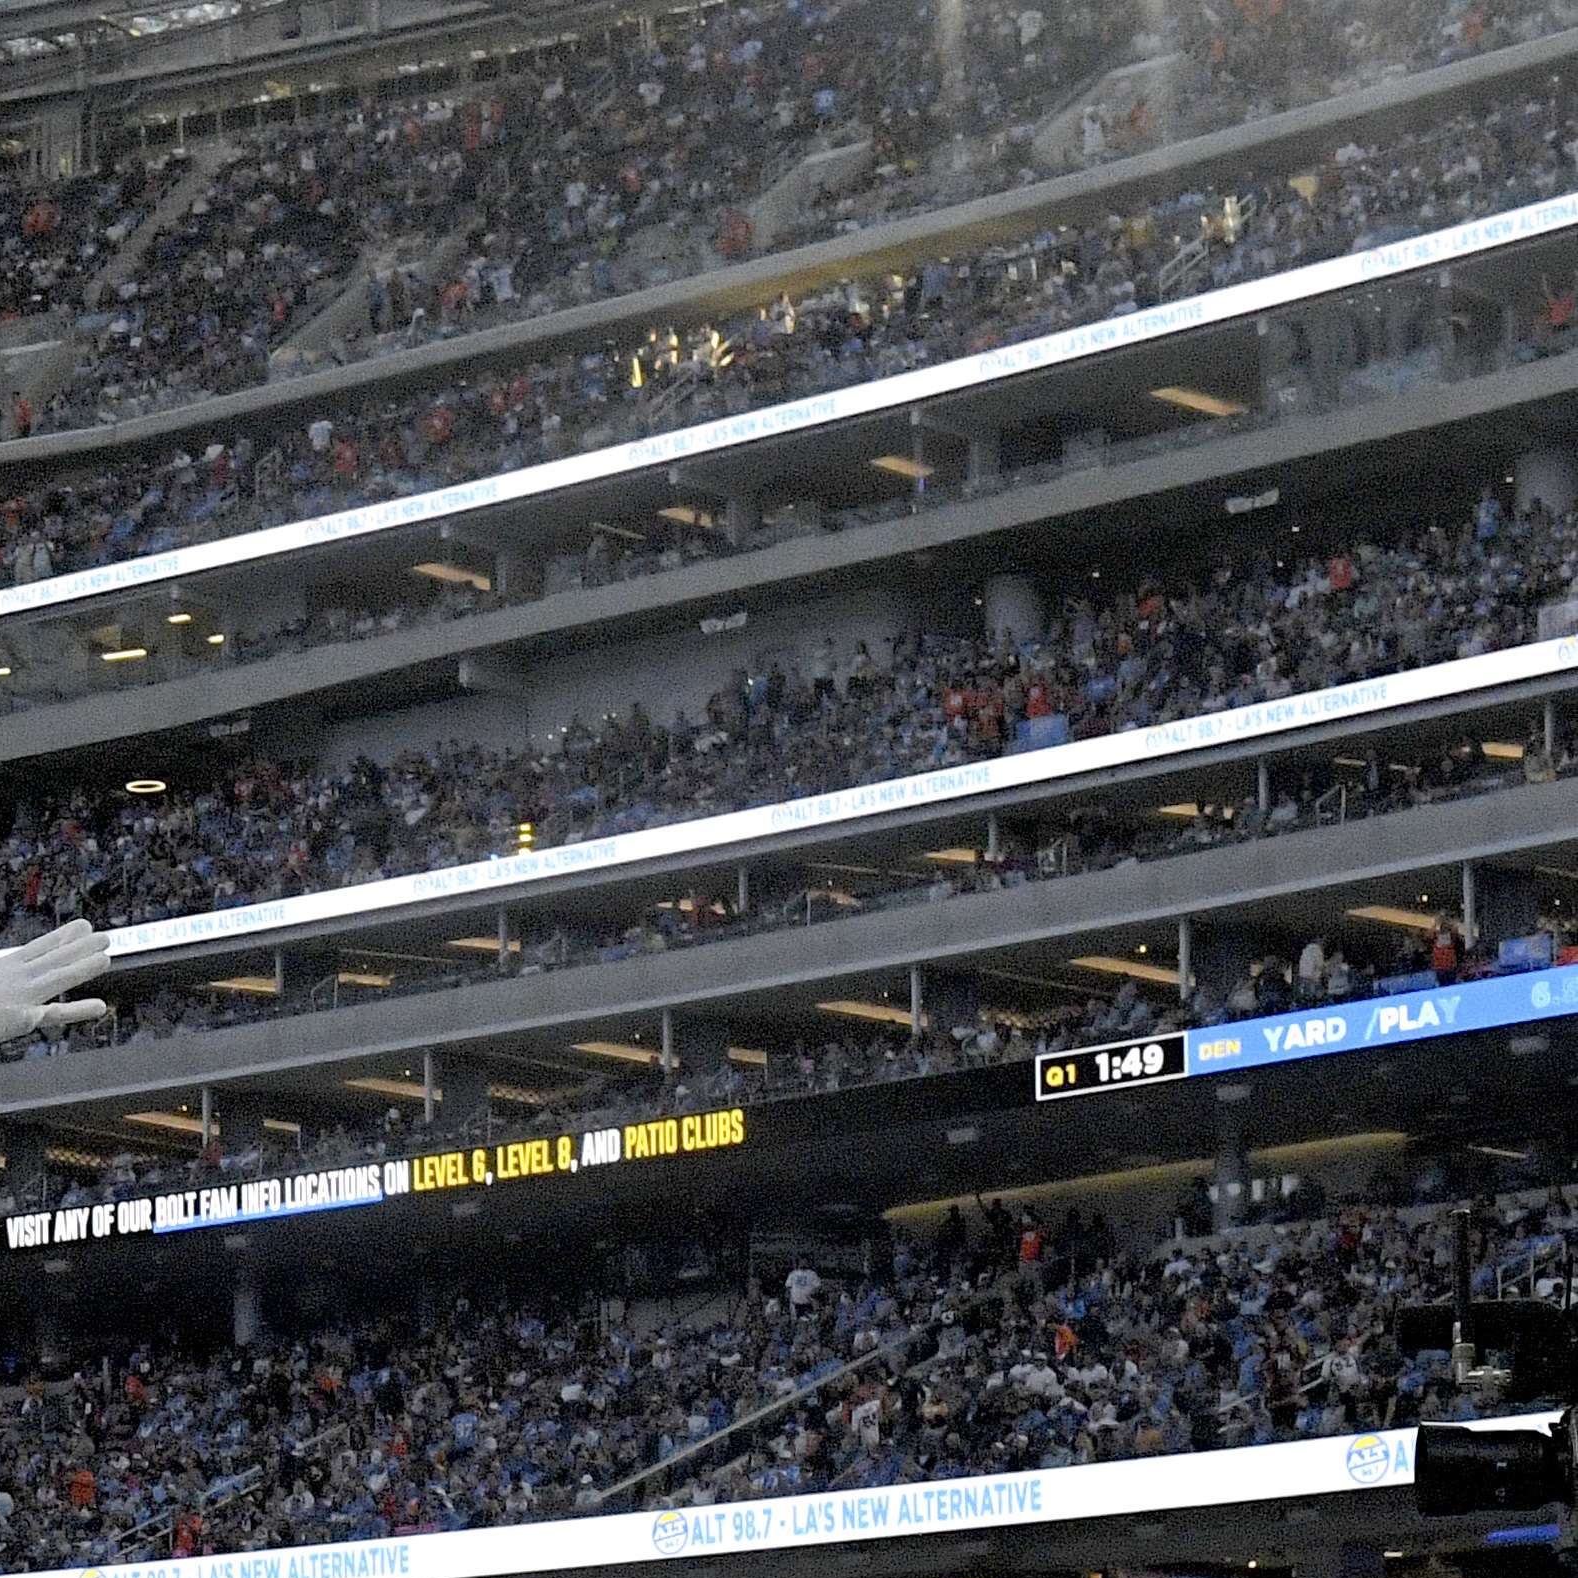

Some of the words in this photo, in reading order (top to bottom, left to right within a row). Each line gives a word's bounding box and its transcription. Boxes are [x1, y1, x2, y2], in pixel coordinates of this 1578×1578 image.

[1002, 349, 1023, 369] ALT
[1089, 324, 1117, 346] NEW
[1122, 301, 1203, 338] ALTERNATIVE
[1171, 723, 1192, 745] ALT
[1197, 717, 1223, 739] 98.7
[1235, 709, 1262, 731] LA'S
[1266, 702, 1295, 725] NEW
[1300, 681, 1386, 717] ALTERNATIVE
[793, 802, 813, 822] ALT
[817, 796, 840, 817] 98.7
[851, 789, 875, 810] LA'S
[879, 783, 906, 804] NEW
[911, 765, 991, 798] ALTERNATIVE
[487, 861, 511, 880] LA'S
[513, 856, 537, 875] NEW
[543, 841, 616, 870] ALTERNATIVE
[116, 931, 133, 947] ALT
[165, 921, 187, 939] LA'S
[190, 917, 213, 935] NEW
[217, 904, 285, 930] ALTERNATIVE
[1044, 1063, 1078, 1087] Q1
[1094, 1043, 1165, 1083] 1:49
[1198, 1038, 1242, 1062] DEN
[1262, 1017, 1348, 1052] YARD
[6, 1212, 52, 1249] VISIT
[53, 1207, 90, 1243] ANY
[92, 1203, 115, 1238] OF
[117, 1198, 153, 1235] OUR
[155, 1191, 197, 1228] BOLT
[200, 1185, 238, 1221] FAM
[241, 1178, 281, 1215] INFO
[284, 1163, 382, 1209] LOCATIONS
[384, 1159, 410, 1196] ON
[413, 1152, 470, 1192] LEVEL
[496, 1139, 554, 1179] LEVEL
[556, 1135, 579, 1173] 8,
[581, 1127, 621, 1167] AND
[623, 1118, 679, 1160] PATIO
[681, 1107, 744, 1152] CLUBS
[690, 1513, 725, 1545] ALT
[731, 1508, 771, 1541] 98.7
[792, 1501, 835, 1535] LA'S
[841, 1495, 889, 1530] NEW
[897, 1479, 1041, 1525] ALTERNATIVE
